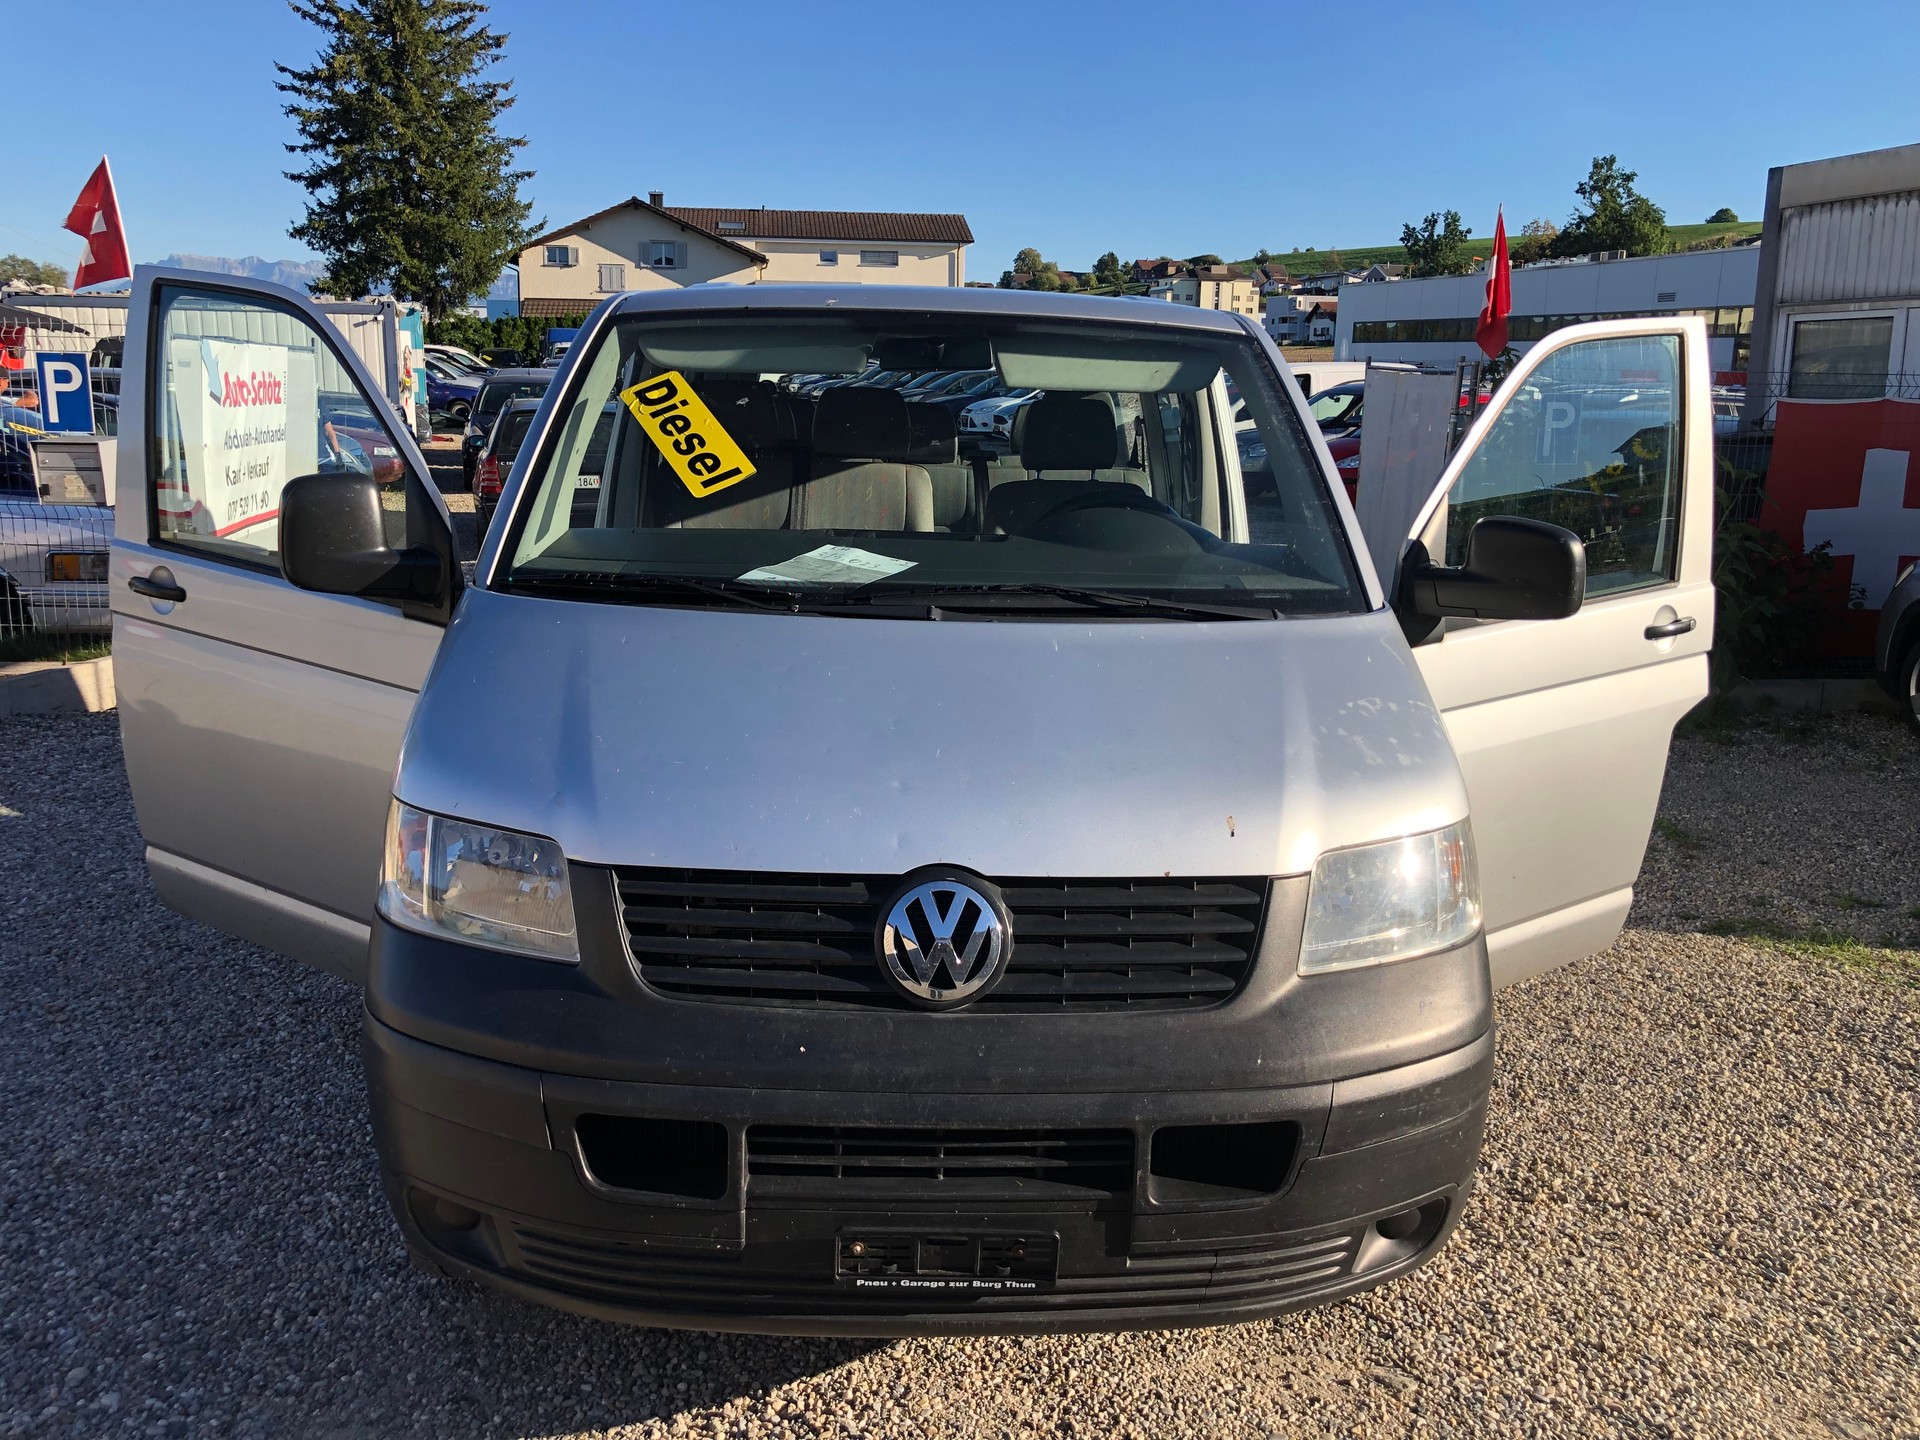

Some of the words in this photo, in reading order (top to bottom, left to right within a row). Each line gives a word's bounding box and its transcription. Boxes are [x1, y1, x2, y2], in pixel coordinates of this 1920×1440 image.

[43, 361, 83, 423] P
[222, 370, 282, 407] Auto-Schötz
[633, 378, 743, 489] Diesel
[247, 456, 269, 480] Verkauf
[883, 880, 1001, 1001] VW
[856, 1279, 888, 1287] Pneu
[900, 1279, 946, 1288] Garage
[972, 1280, 1002, 1289] Burg
